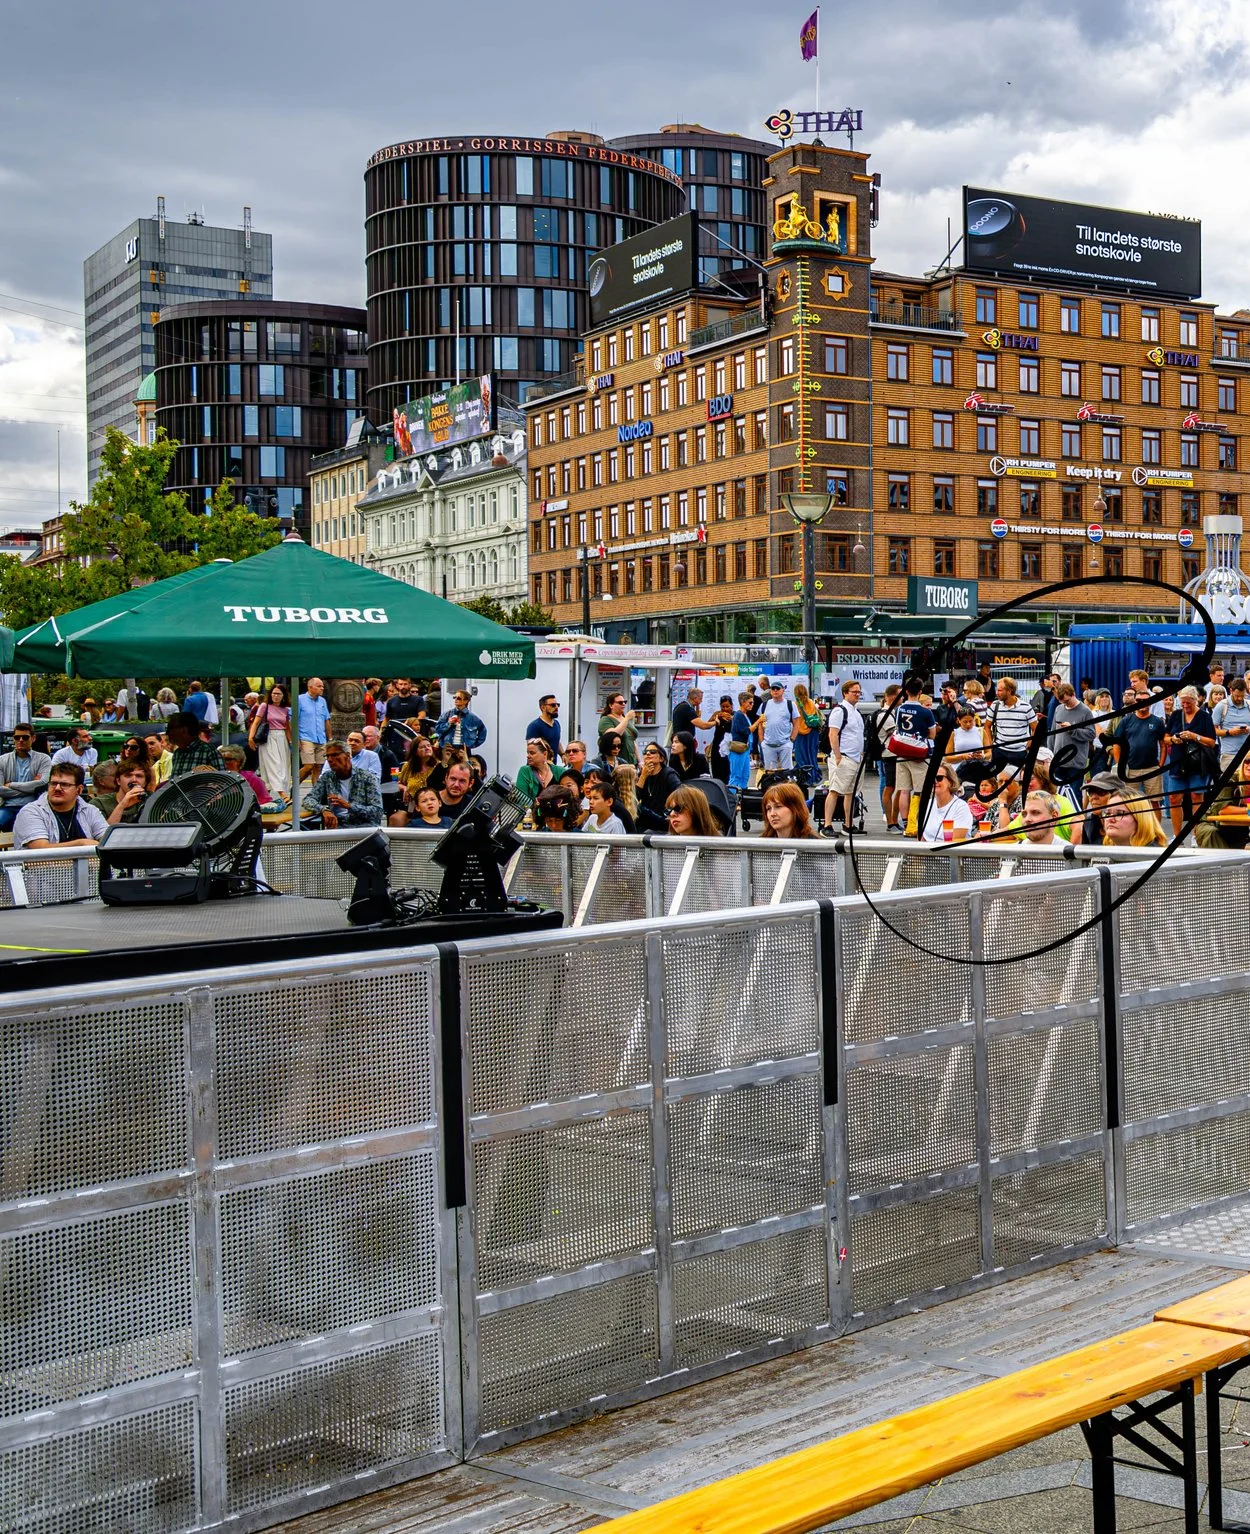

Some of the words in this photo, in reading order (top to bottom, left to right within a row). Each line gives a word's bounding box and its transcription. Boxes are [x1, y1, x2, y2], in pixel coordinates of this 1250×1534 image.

[796, 110, 863, 133] THAI
[375, 138, 452, 164] FEDERSPIEL
[471, 138, 580, 156] GORRISSEN
[588, 147, 670, 180] FEDERSPIEL
[1075, 225, 1091, 241] Til
[1092, 228, 1139, 247] landets
[1140, 237, 1182, 254] største
[1075, 243, 1142, 262] snotskovle
[1001, 333, 1039, 350] THAI
[663, 351, 682, 367] THAI
[1164, 350, 1199, 368] THAI
[596, 373, 613, 389] THAI
[709, 395, 732, 416] BDO
[617, 419, 652, 442] Nordea
[1011, 469, 1053, 477] ENGINEERING
[1020, 460, 1056, 469] PUMPER
[1066, 465, 1094, 480] Keep
[1094, 467, 1103, 478] it
[1103, 468, 1123, 482] dry
[1147, 469, 1159, 477] RH
[1160, 470, 1193, 479] PUMPER
[1152, 479, 1190, 487] ENGINEERING
[1009, 525, 1040, 534] THIRSTY
[1041, 526, 1059, 535] FOR
[1059, 527, 1086, 536] MORE
[1105, 530, 1134, 538] THIRSTY
[1134, 531, 1152, 539] FOR
[1152, 532, 1177, 541] MORE
[925, 584, 969, 609] TUBORG
[223, 605, 389, 624] TUBORG
[836, 653, 897, 664] ESPRESSO
[852, 669, 889, 680] Wristband
[901, 713, 914, 731] 3
